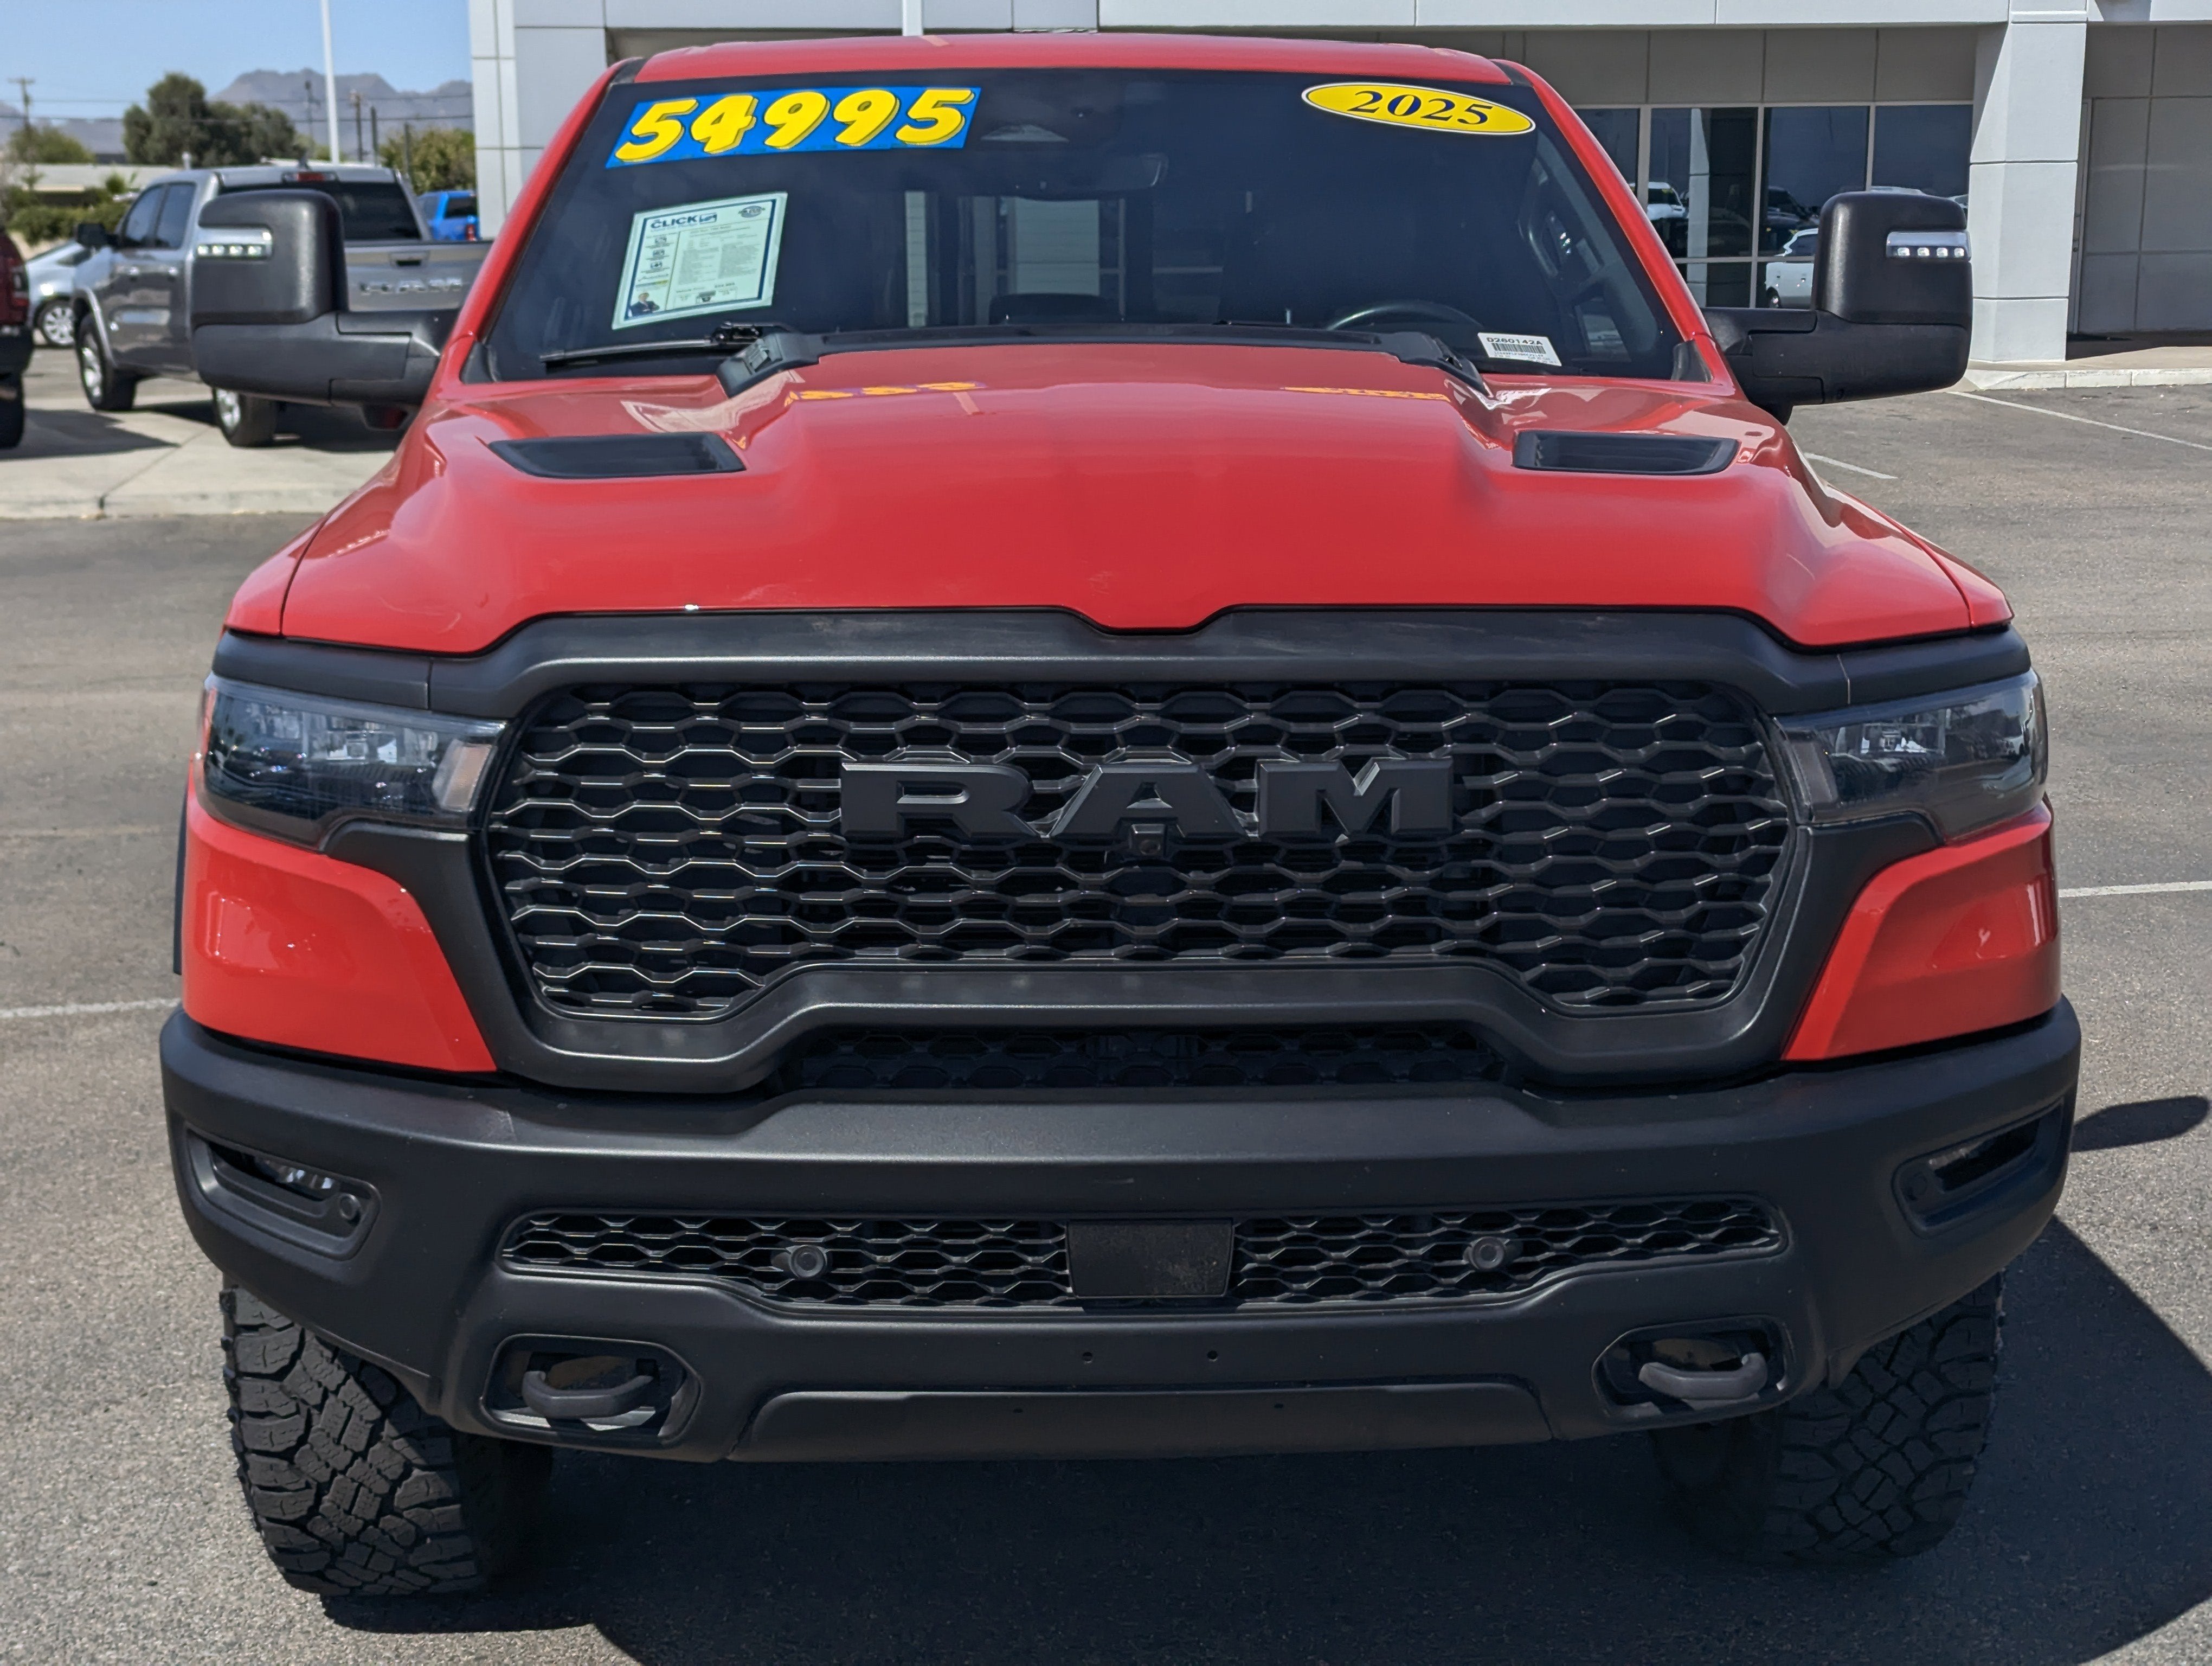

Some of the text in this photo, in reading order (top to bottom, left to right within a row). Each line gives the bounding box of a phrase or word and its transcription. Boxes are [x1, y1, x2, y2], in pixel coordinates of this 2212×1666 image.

[615, 88, 975, 162] 54995
[1347, 91, 1493, 125] 2025
[651, 215, 697, 228] CLICK
[840, 761, 1454, 838] RAM
